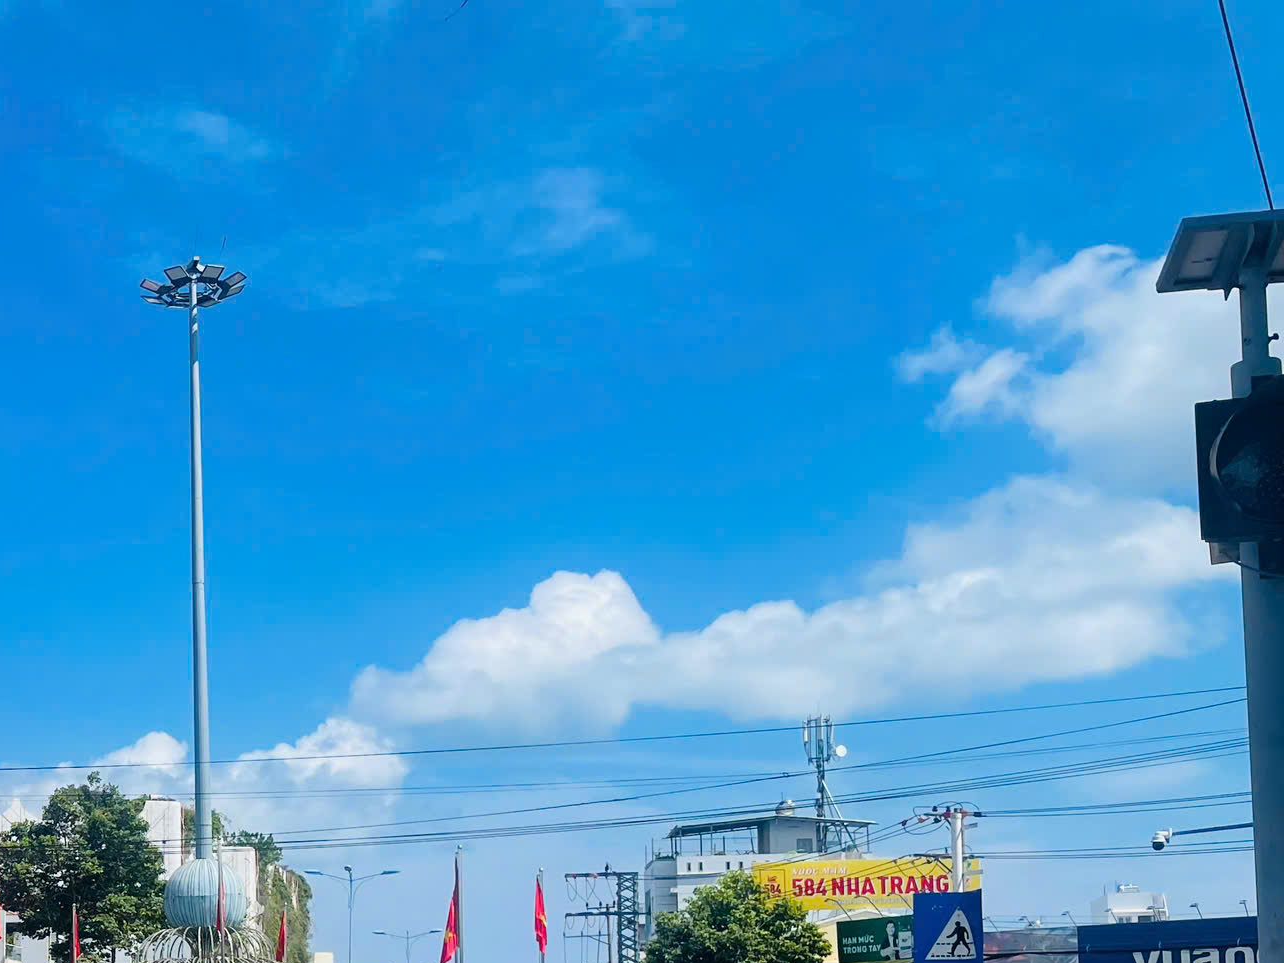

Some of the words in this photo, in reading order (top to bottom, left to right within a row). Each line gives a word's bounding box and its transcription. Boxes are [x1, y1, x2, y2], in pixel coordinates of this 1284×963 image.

[792, 878, 827, 896] 584
[832, 876, 875, 896] NHA
[878, 874, 949, 895] TRANG
[868, 944, 881, 952] TAY
